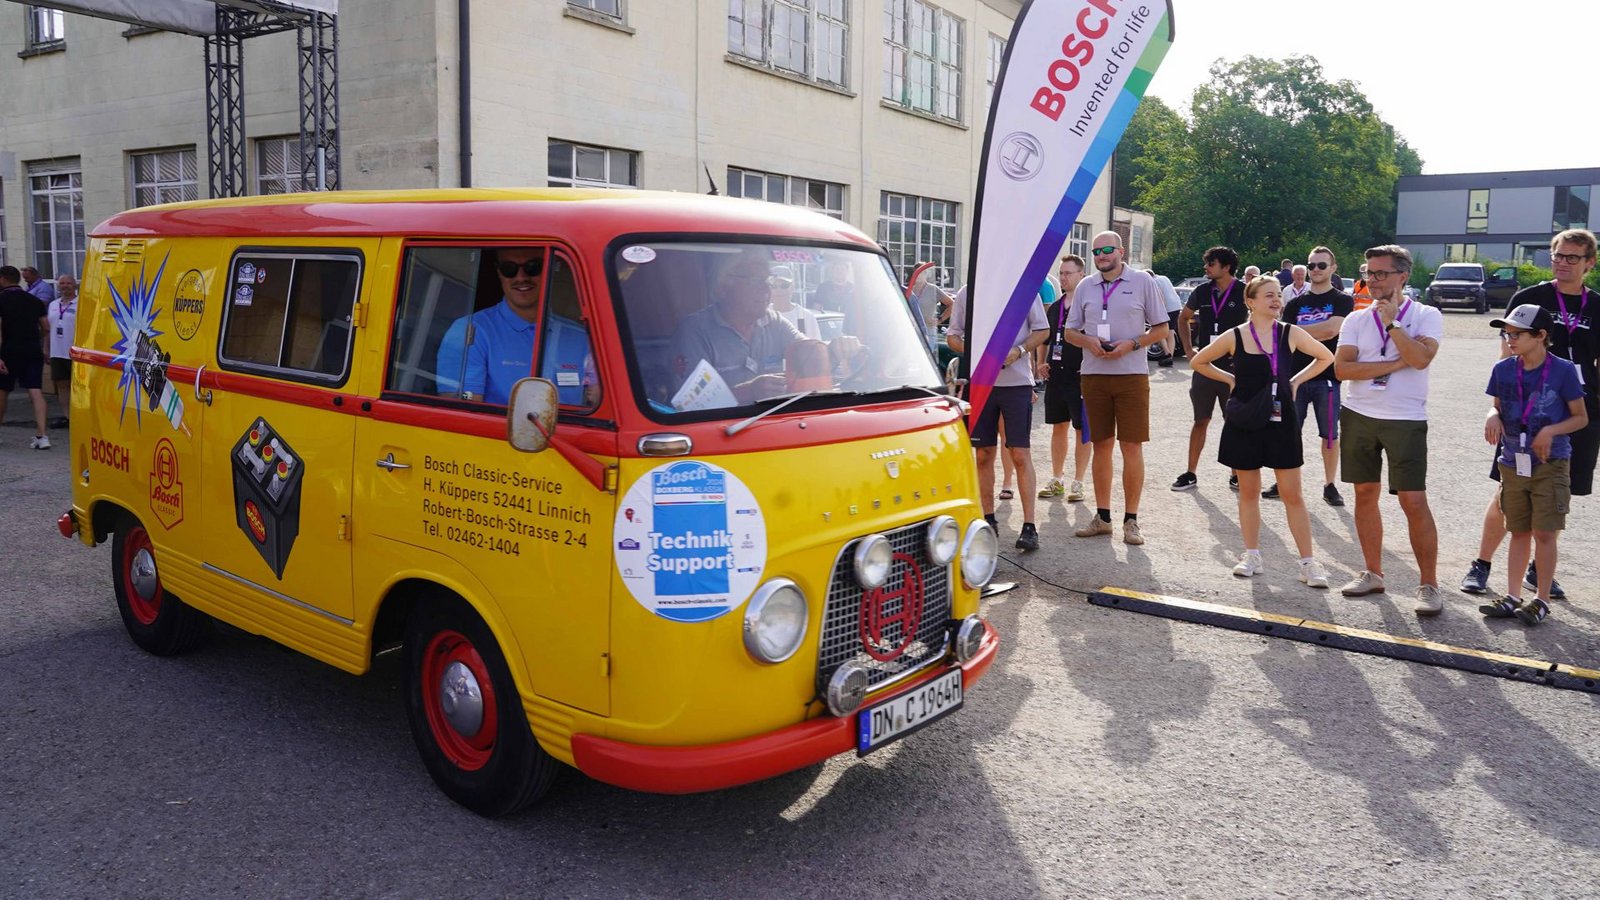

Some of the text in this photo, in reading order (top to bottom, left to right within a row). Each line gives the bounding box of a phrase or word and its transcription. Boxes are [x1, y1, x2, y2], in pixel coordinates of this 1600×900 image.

[1069, 5, 1151, 138] Invented for life
[771, 250, 814, 264] BOSCH
[174, 295, 204, 314] KÜPPERS
[90, 436, 129, 473] BOSCH
[424, 455, 563, 495] Bosch Classic-Service
[656, 465, 708, 487] Bosch
[152, 485, 180, 508] Bosch
[423, 477, 592, 525] H. Küppers 52441 Linnich
[422, 519, 521, 557] Tel. 02462-1404
[423, 498, 588, 549] Robert-Bosch-Strasse 2-4
[648, 529, 733, 550] Technik
[647, 548, 735, 575] Support
[873, 674, 960, 739] DN C 1964H
